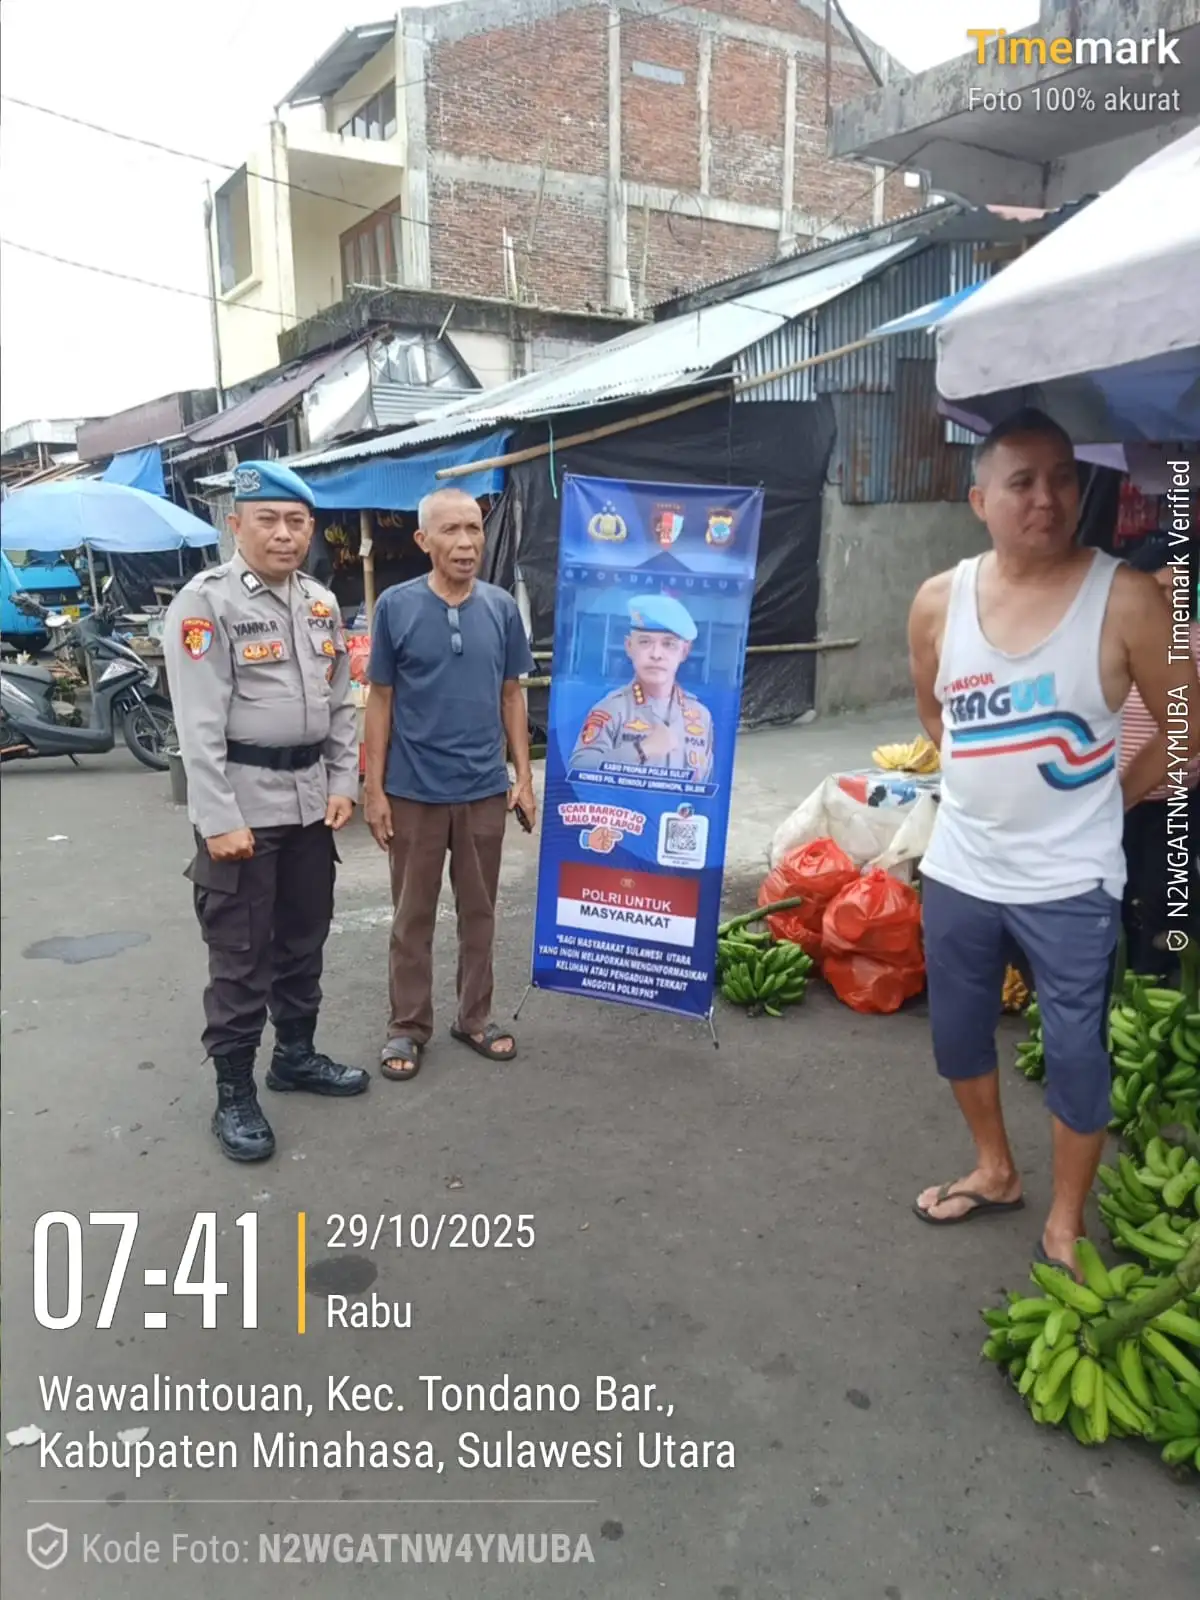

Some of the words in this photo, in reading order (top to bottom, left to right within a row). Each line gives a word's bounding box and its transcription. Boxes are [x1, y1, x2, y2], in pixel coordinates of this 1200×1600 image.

[560, 804, 586, 813] SCAN
[589, 805, 629, 818] BARKOT
[630, 813, 644, 823] JO
[565, 815, 589, 823] KALO
[591, 816, 608, 824] MO
[582, 888, 621, 904] POLRI
[625, 894, 672, 912] UNTUK
[580, 904, 671, 928] MASYARAKAT
[538, 945, 558, 955] YANG
[577, 937, 625, 953] MASYARAKAT
[626, 945, 663, 960] SULAWESI
[666, 951, 691, 965] UTARA
[555, 960, 589, 974] KELUHAN
[590, 966, 609, 977] ATAU
[610, 970, 653, 984] PENGADUAN
[656, 978, 688, 991] TERKAIT
[581, 978, 615, 991] ANGGOTA
